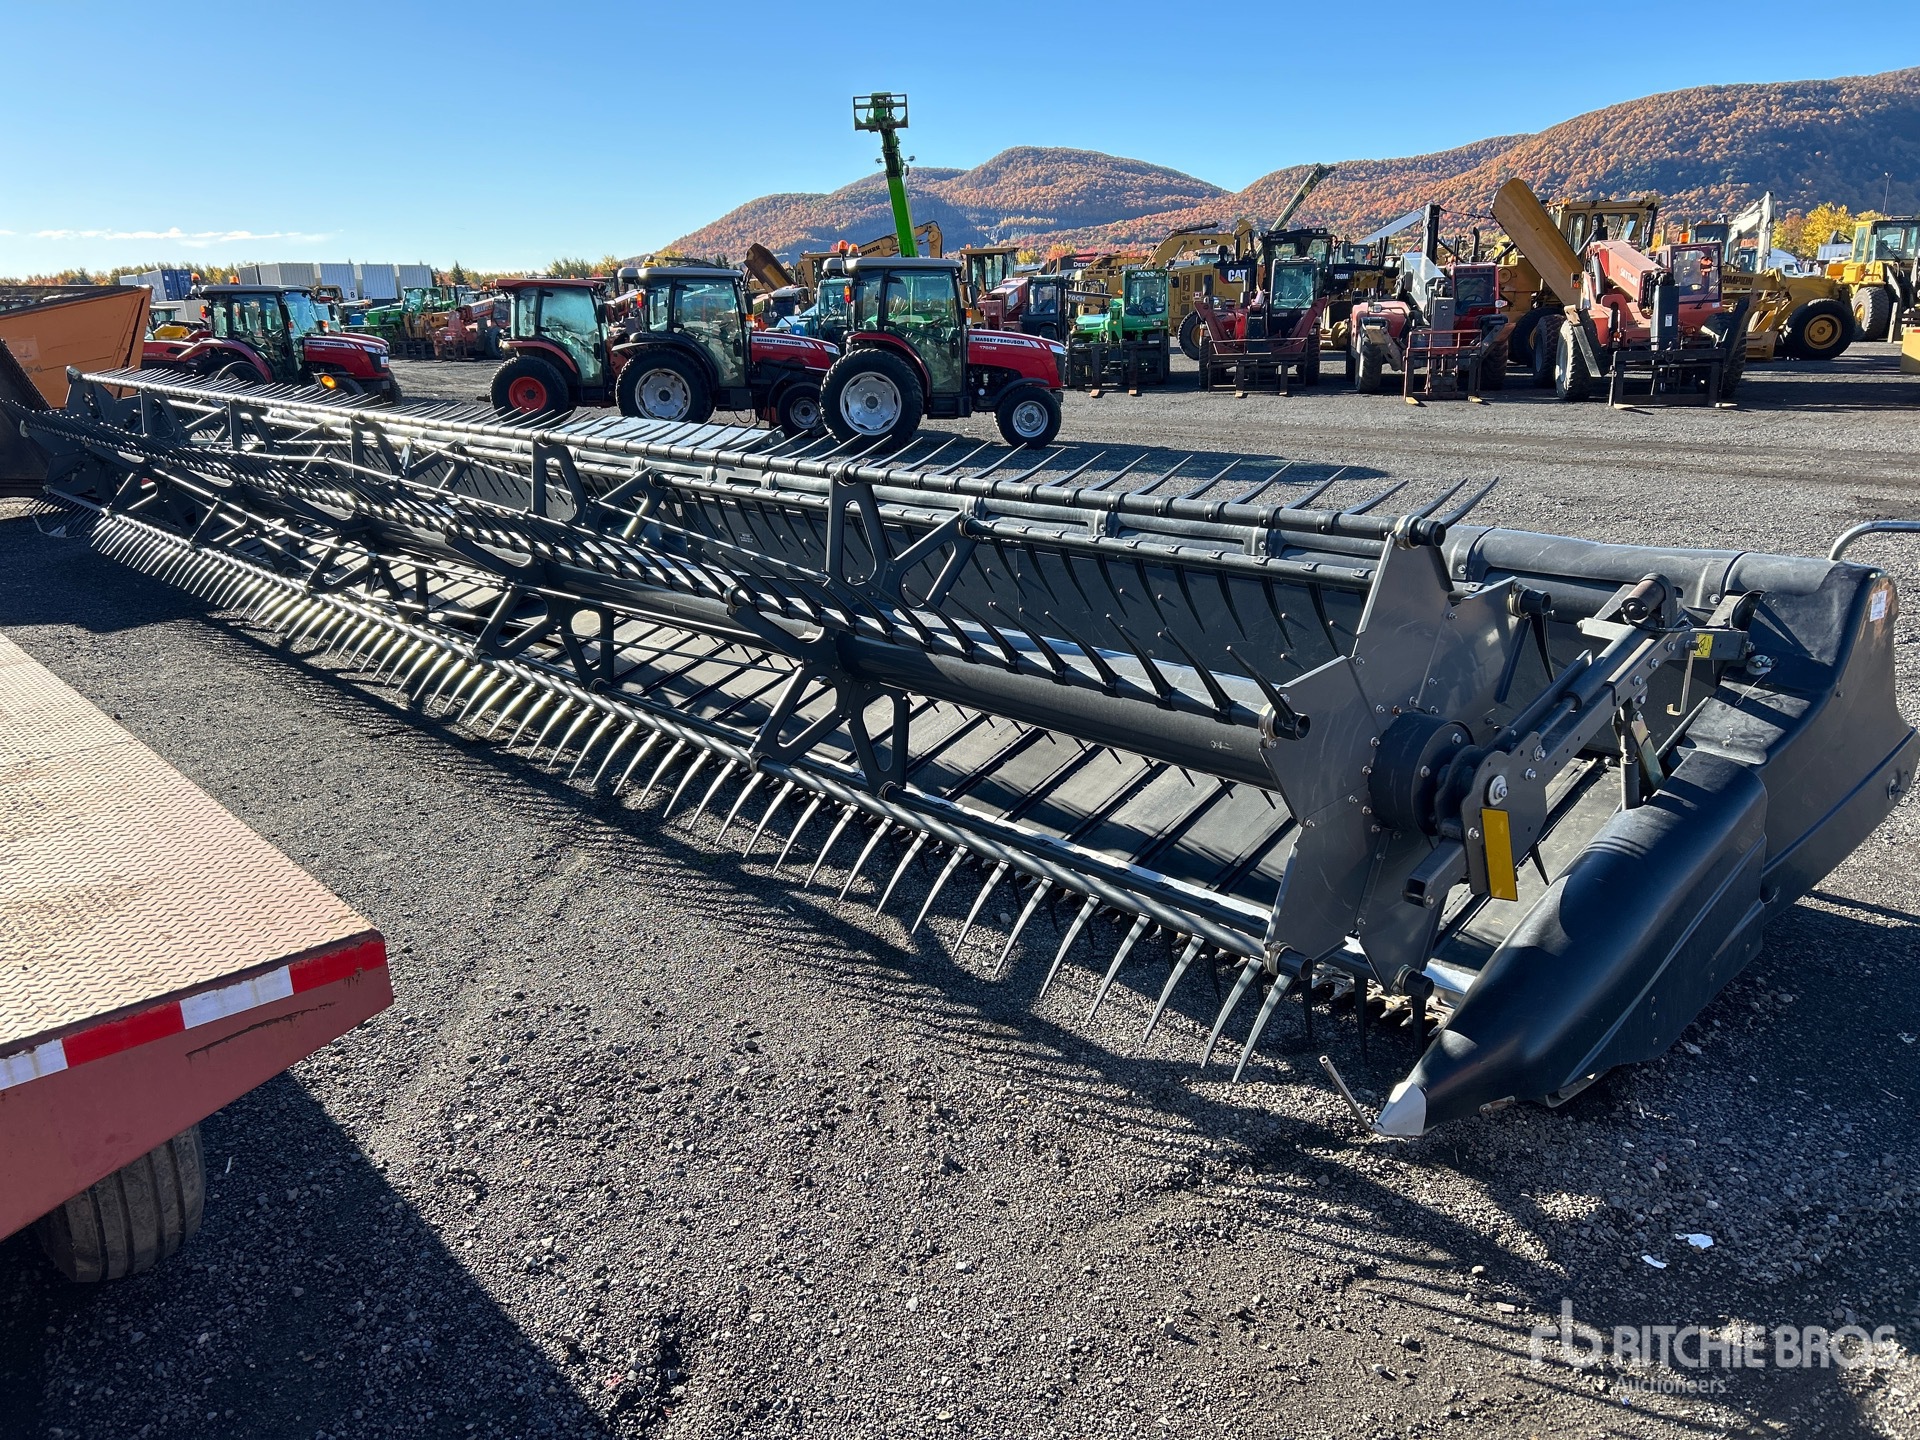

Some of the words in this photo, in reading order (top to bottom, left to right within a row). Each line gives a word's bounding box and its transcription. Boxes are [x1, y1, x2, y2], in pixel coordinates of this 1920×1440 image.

[1227, 269, 1248, 283] CAT
[1722, 274, 1754, 286] AMPION
[350, 291, 356, 299] 8
[1067, 294, 1086, 302] 70CH
